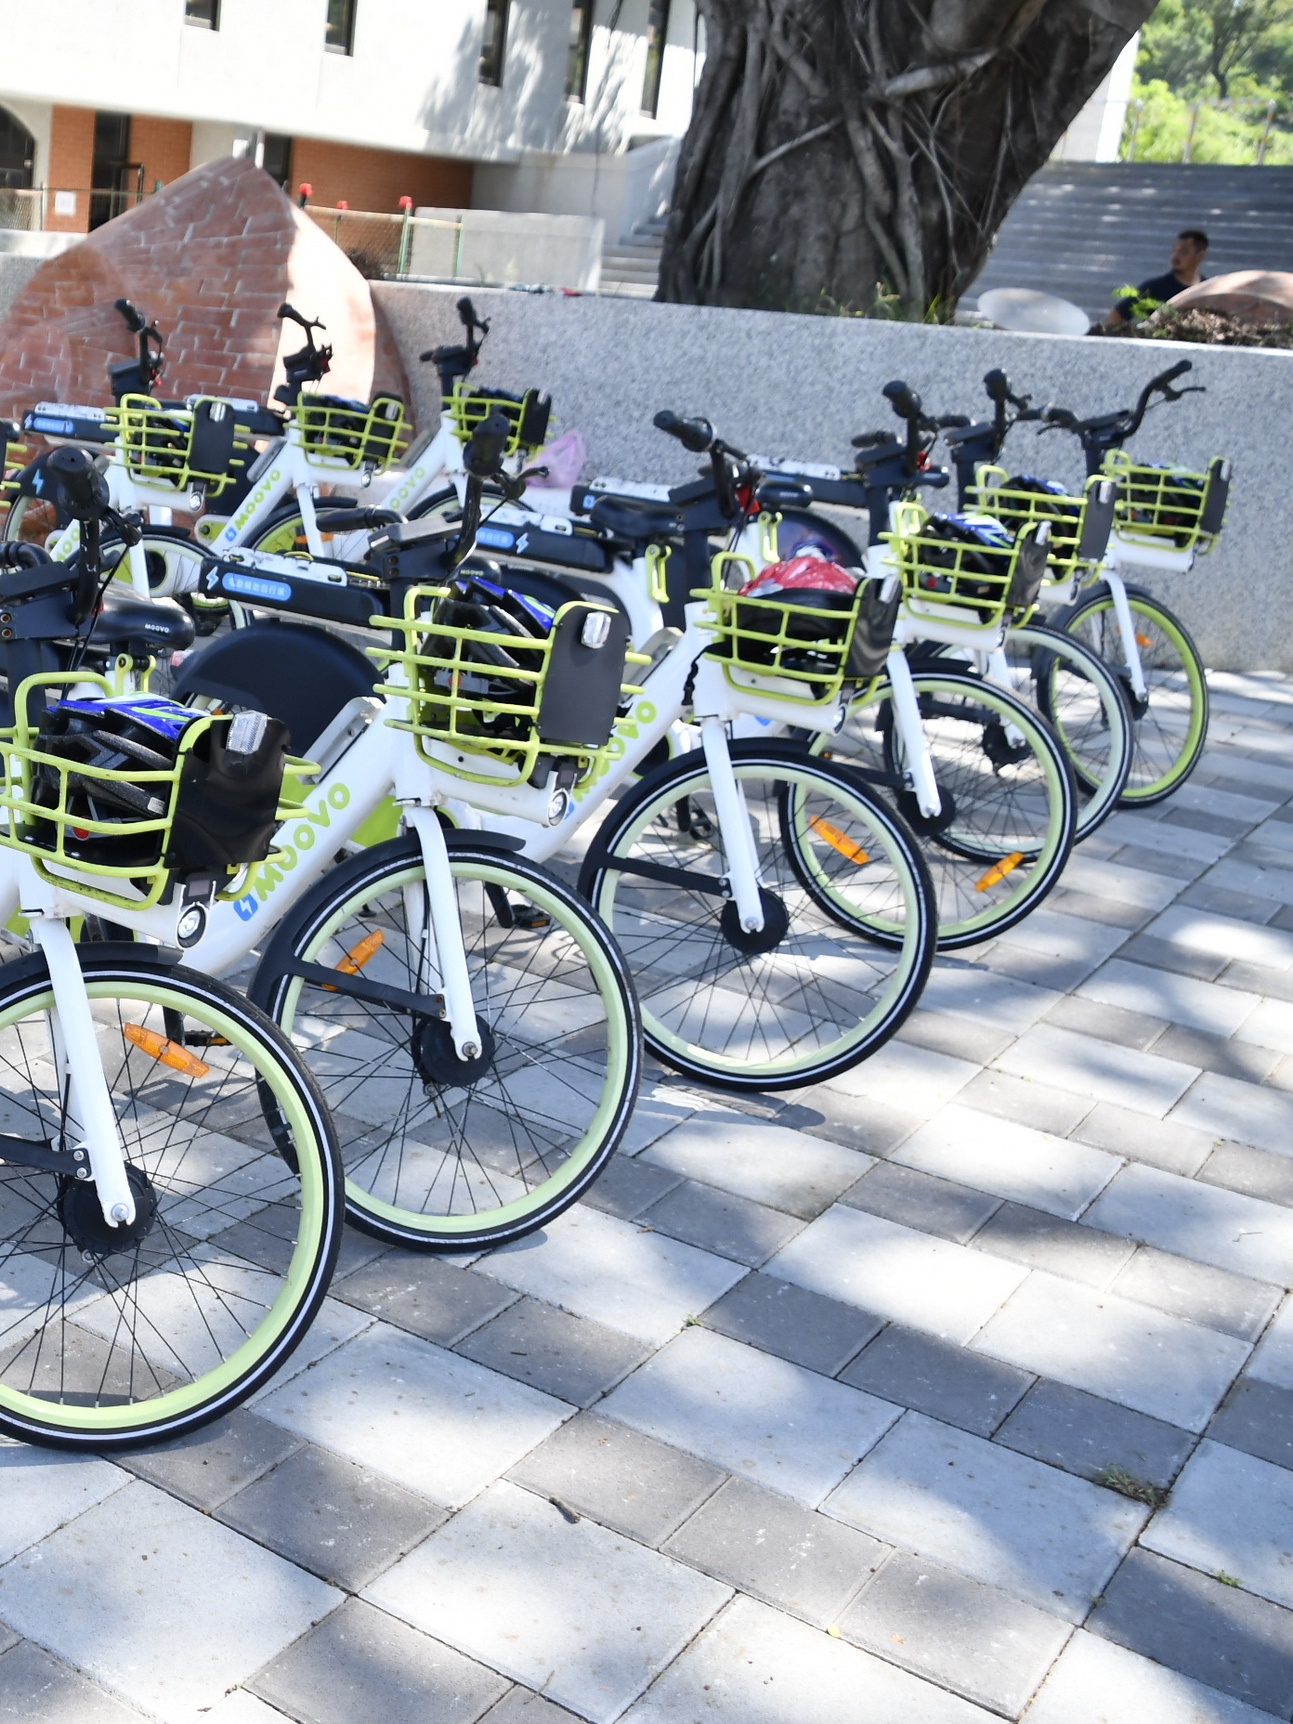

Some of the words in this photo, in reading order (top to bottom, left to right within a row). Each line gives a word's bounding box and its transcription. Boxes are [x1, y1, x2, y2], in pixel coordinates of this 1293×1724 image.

[235, 469, 281, 531] MOOVO
[389, 467, 426, 510] OOVO
[145, 623, 170, 634] MOOVO
[254, 782, 350, 901] MOOVO
